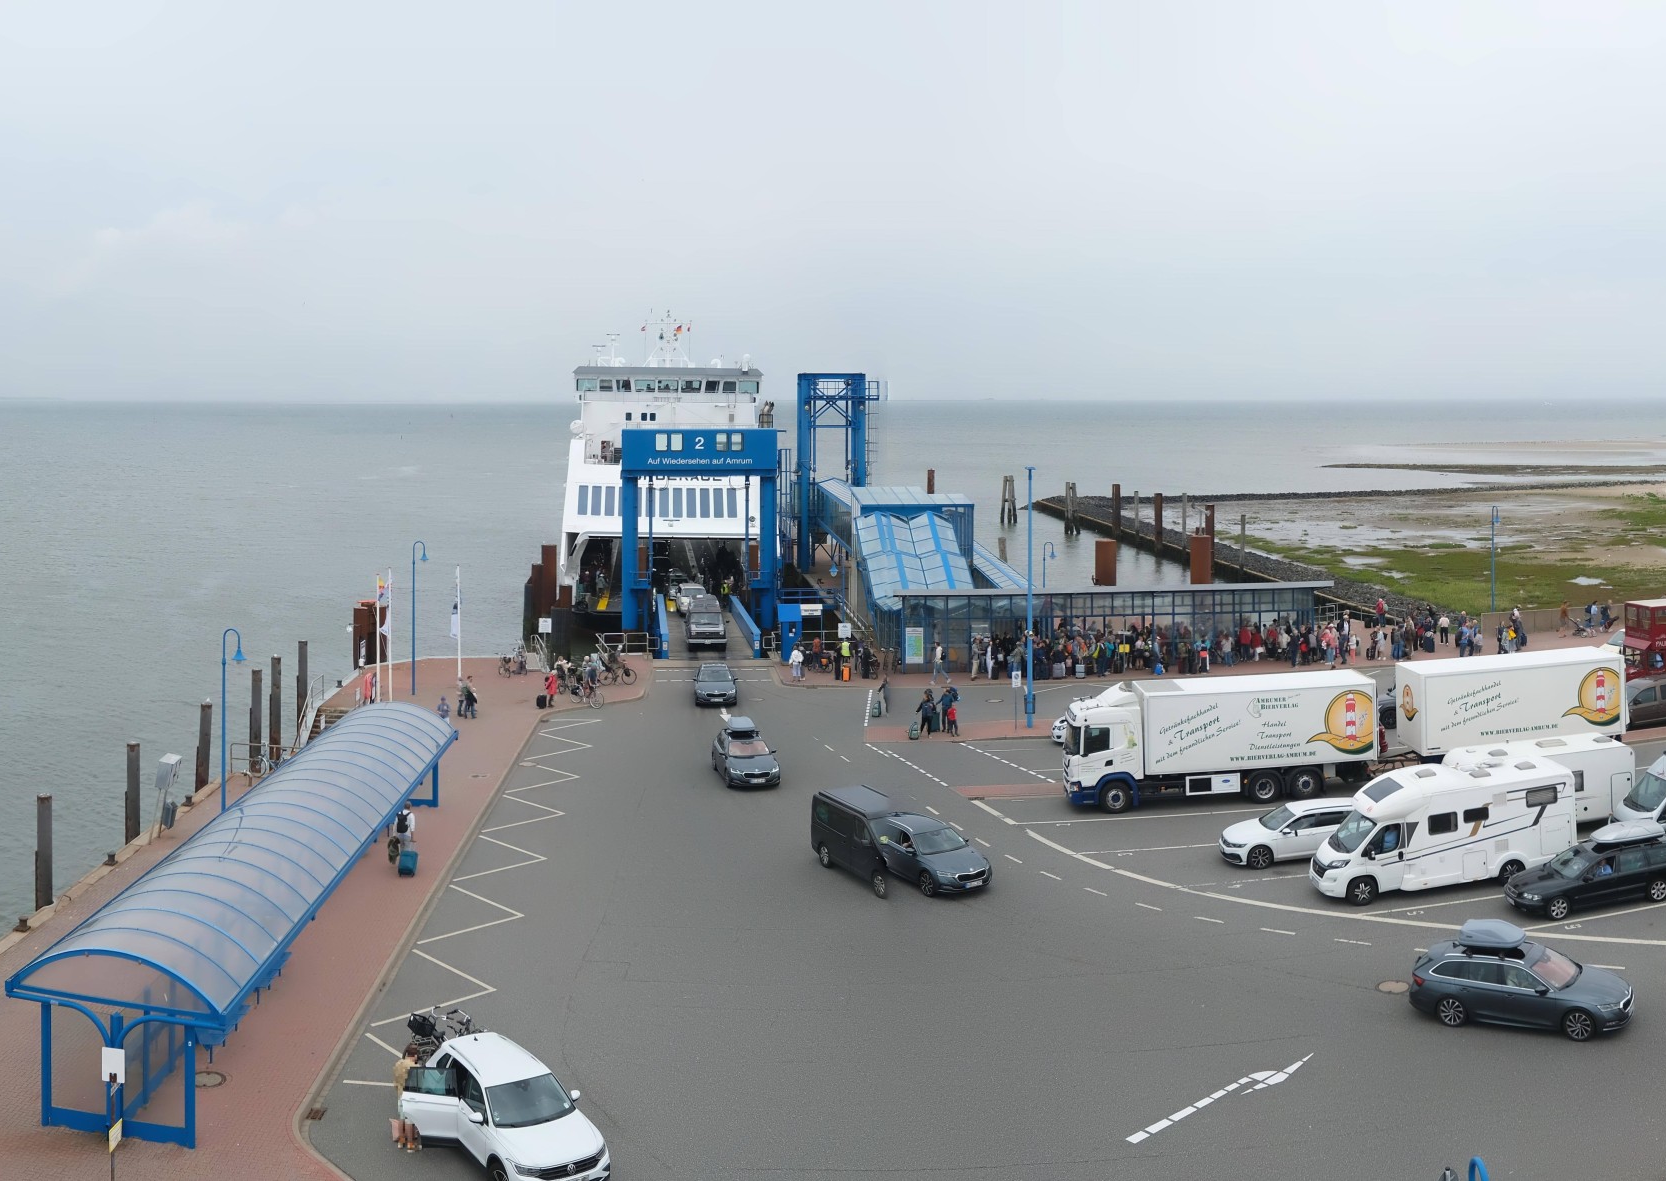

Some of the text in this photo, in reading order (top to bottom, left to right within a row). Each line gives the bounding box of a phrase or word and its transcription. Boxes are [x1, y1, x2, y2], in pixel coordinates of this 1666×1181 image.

[695, 437, 705, 449] 2
[1459, 692, 1501, 712] Transport
[1159, 702, 1218, 735] Getränkefachhandel
[1174, 716, 1220, 740] Transport
[1440, 724, 1450, 732] mit
[1257, 731, 1292, 739] Transport
[1249, 742, 1301, 750] Dienstleistungen
[1155, 756, 1165, 764] mit
[1166, 751, 1178, 759] dem
